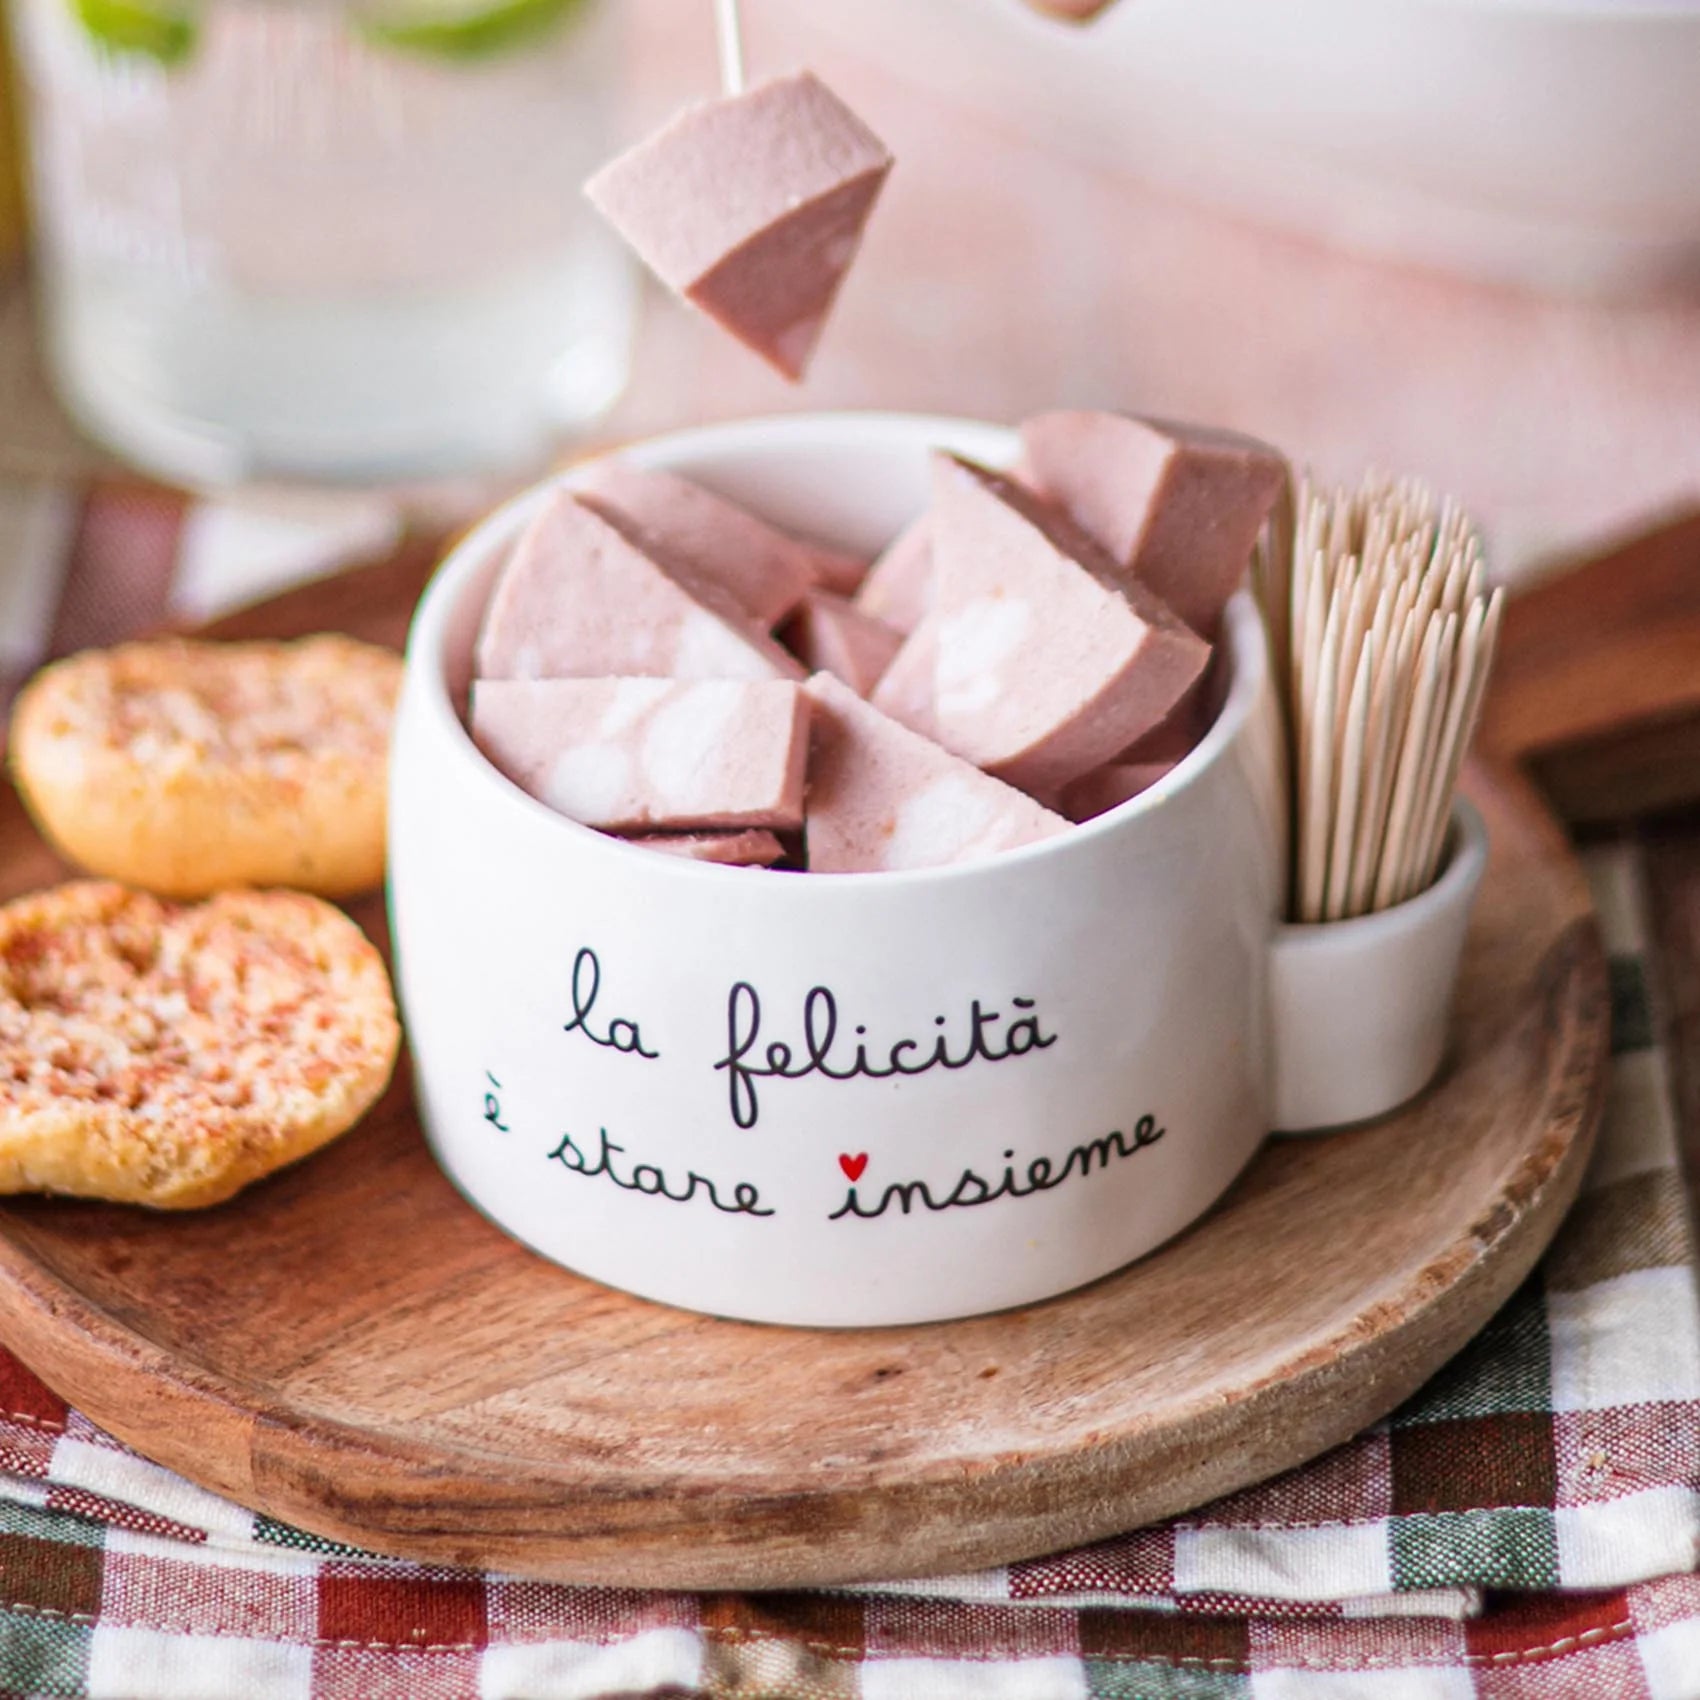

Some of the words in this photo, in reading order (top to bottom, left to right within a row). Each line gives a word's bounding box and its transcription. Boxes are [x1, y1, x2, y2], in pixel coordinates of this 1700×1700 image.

[564, 947, 659, 1059] la
[713, 981, 1058, 1130] felicità
[547, 1128, 776, 1217] stare
[828, 1111, 1166, 1220] insieme
